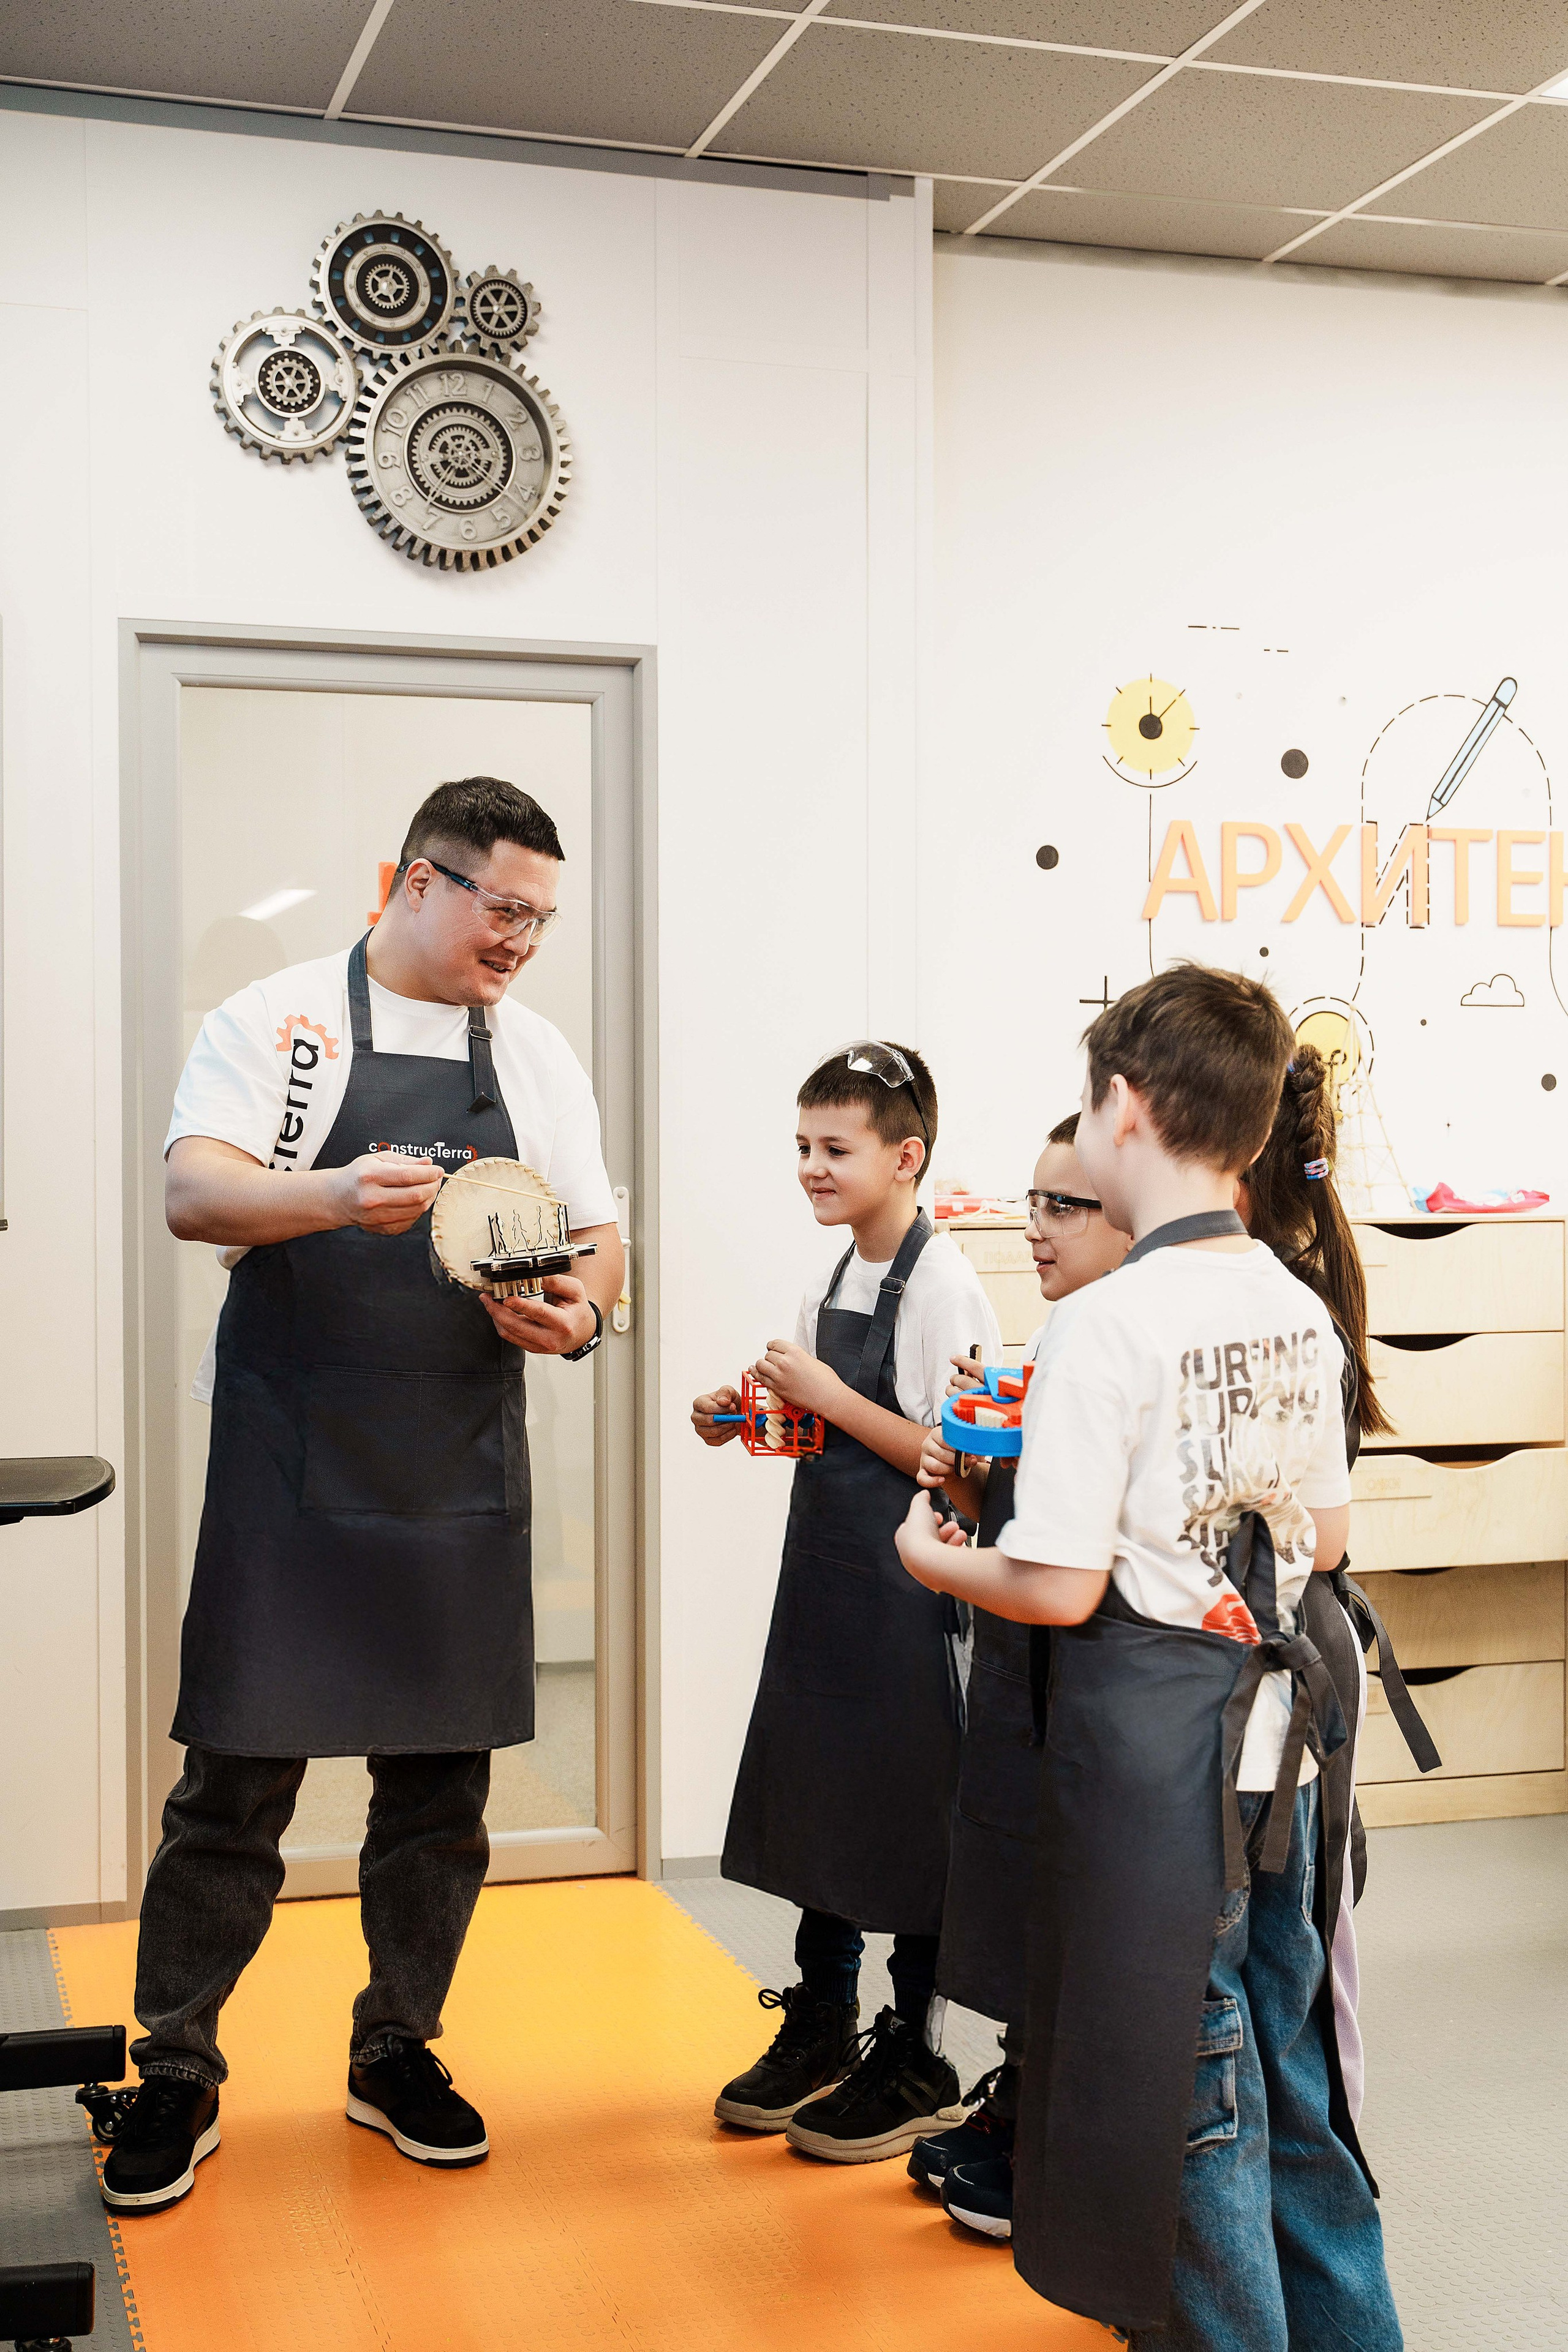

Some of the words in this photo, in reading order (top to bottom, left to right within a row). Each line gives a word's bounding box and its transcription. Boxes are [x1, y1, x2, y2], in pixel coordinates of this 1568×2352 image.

[439, 373, 467, 397] 12
[405, 385, 431, 409] 11
[381, 408, 410, 439] 10
[505, 405, 529, 431] 2
[378, 450, 402, 470] 9
[520, 445, 541, 461] 3
[390, 484, 414, 507] 8
[421, 507, 442, 531] 7
[460, 519, 477, 541] 6
[491, 507, 513, 530] 5
